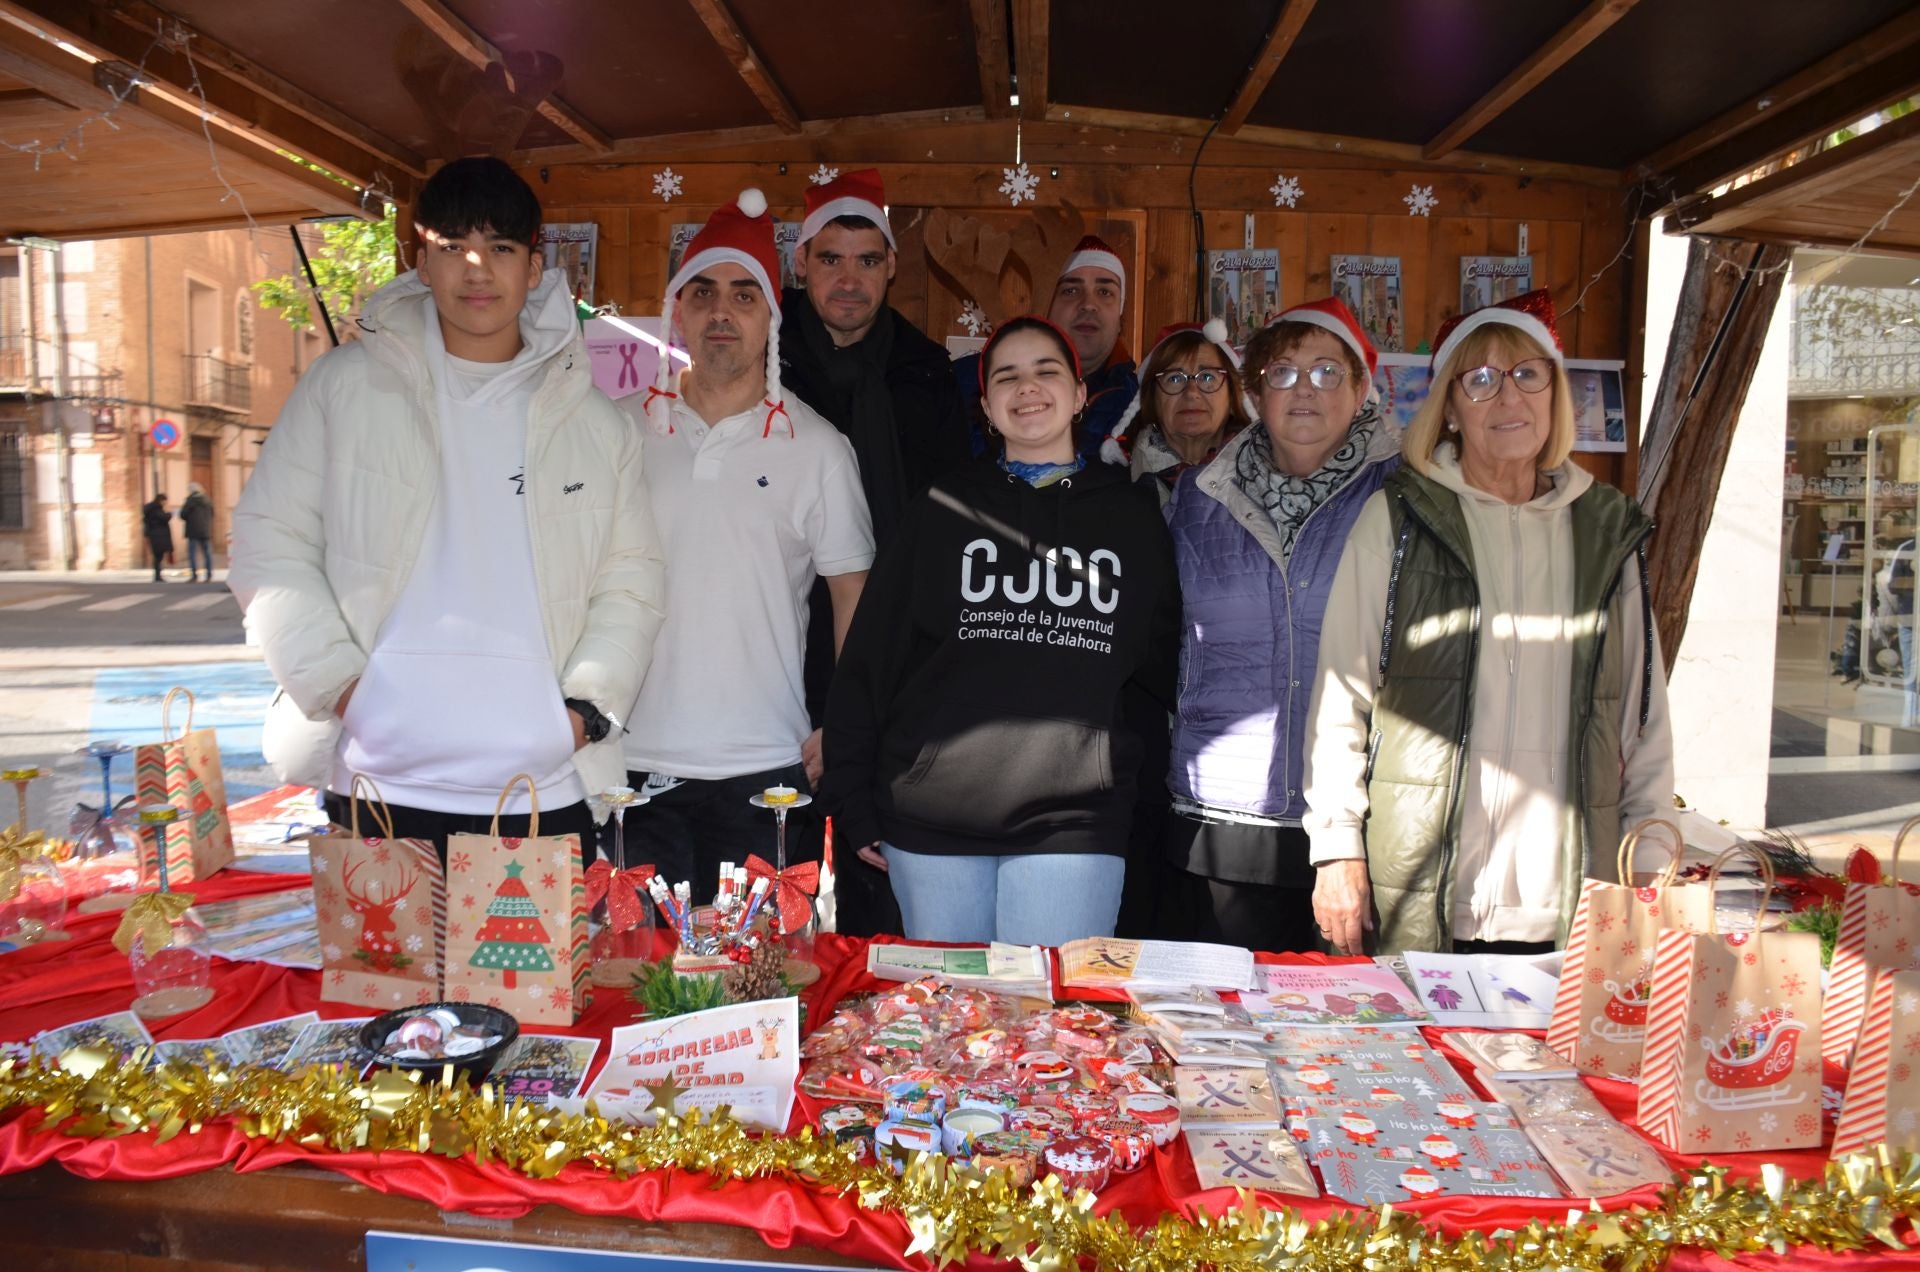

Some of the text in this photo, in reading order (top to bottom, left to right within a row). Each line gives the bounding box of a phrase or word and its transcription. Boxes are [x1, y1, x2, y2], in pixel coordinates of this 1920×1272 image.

[961, 538, 1122, 614] CJCC
[960, 608, 1114, 636] Consejo de la Juventud
[958, 627, 1112, 654] Comarcal de Calahorra
[647, 773, 678, 787] NIKE
[627, 1027, 754, 1066] SORPRESAS
[675, 1061, 705, 1076] DE
[510, 1077, 554, 1092] 30
[1389, 1119, 1449, 1132] Ho ho ho
[1335, 1146, 1358, 1160] ho
